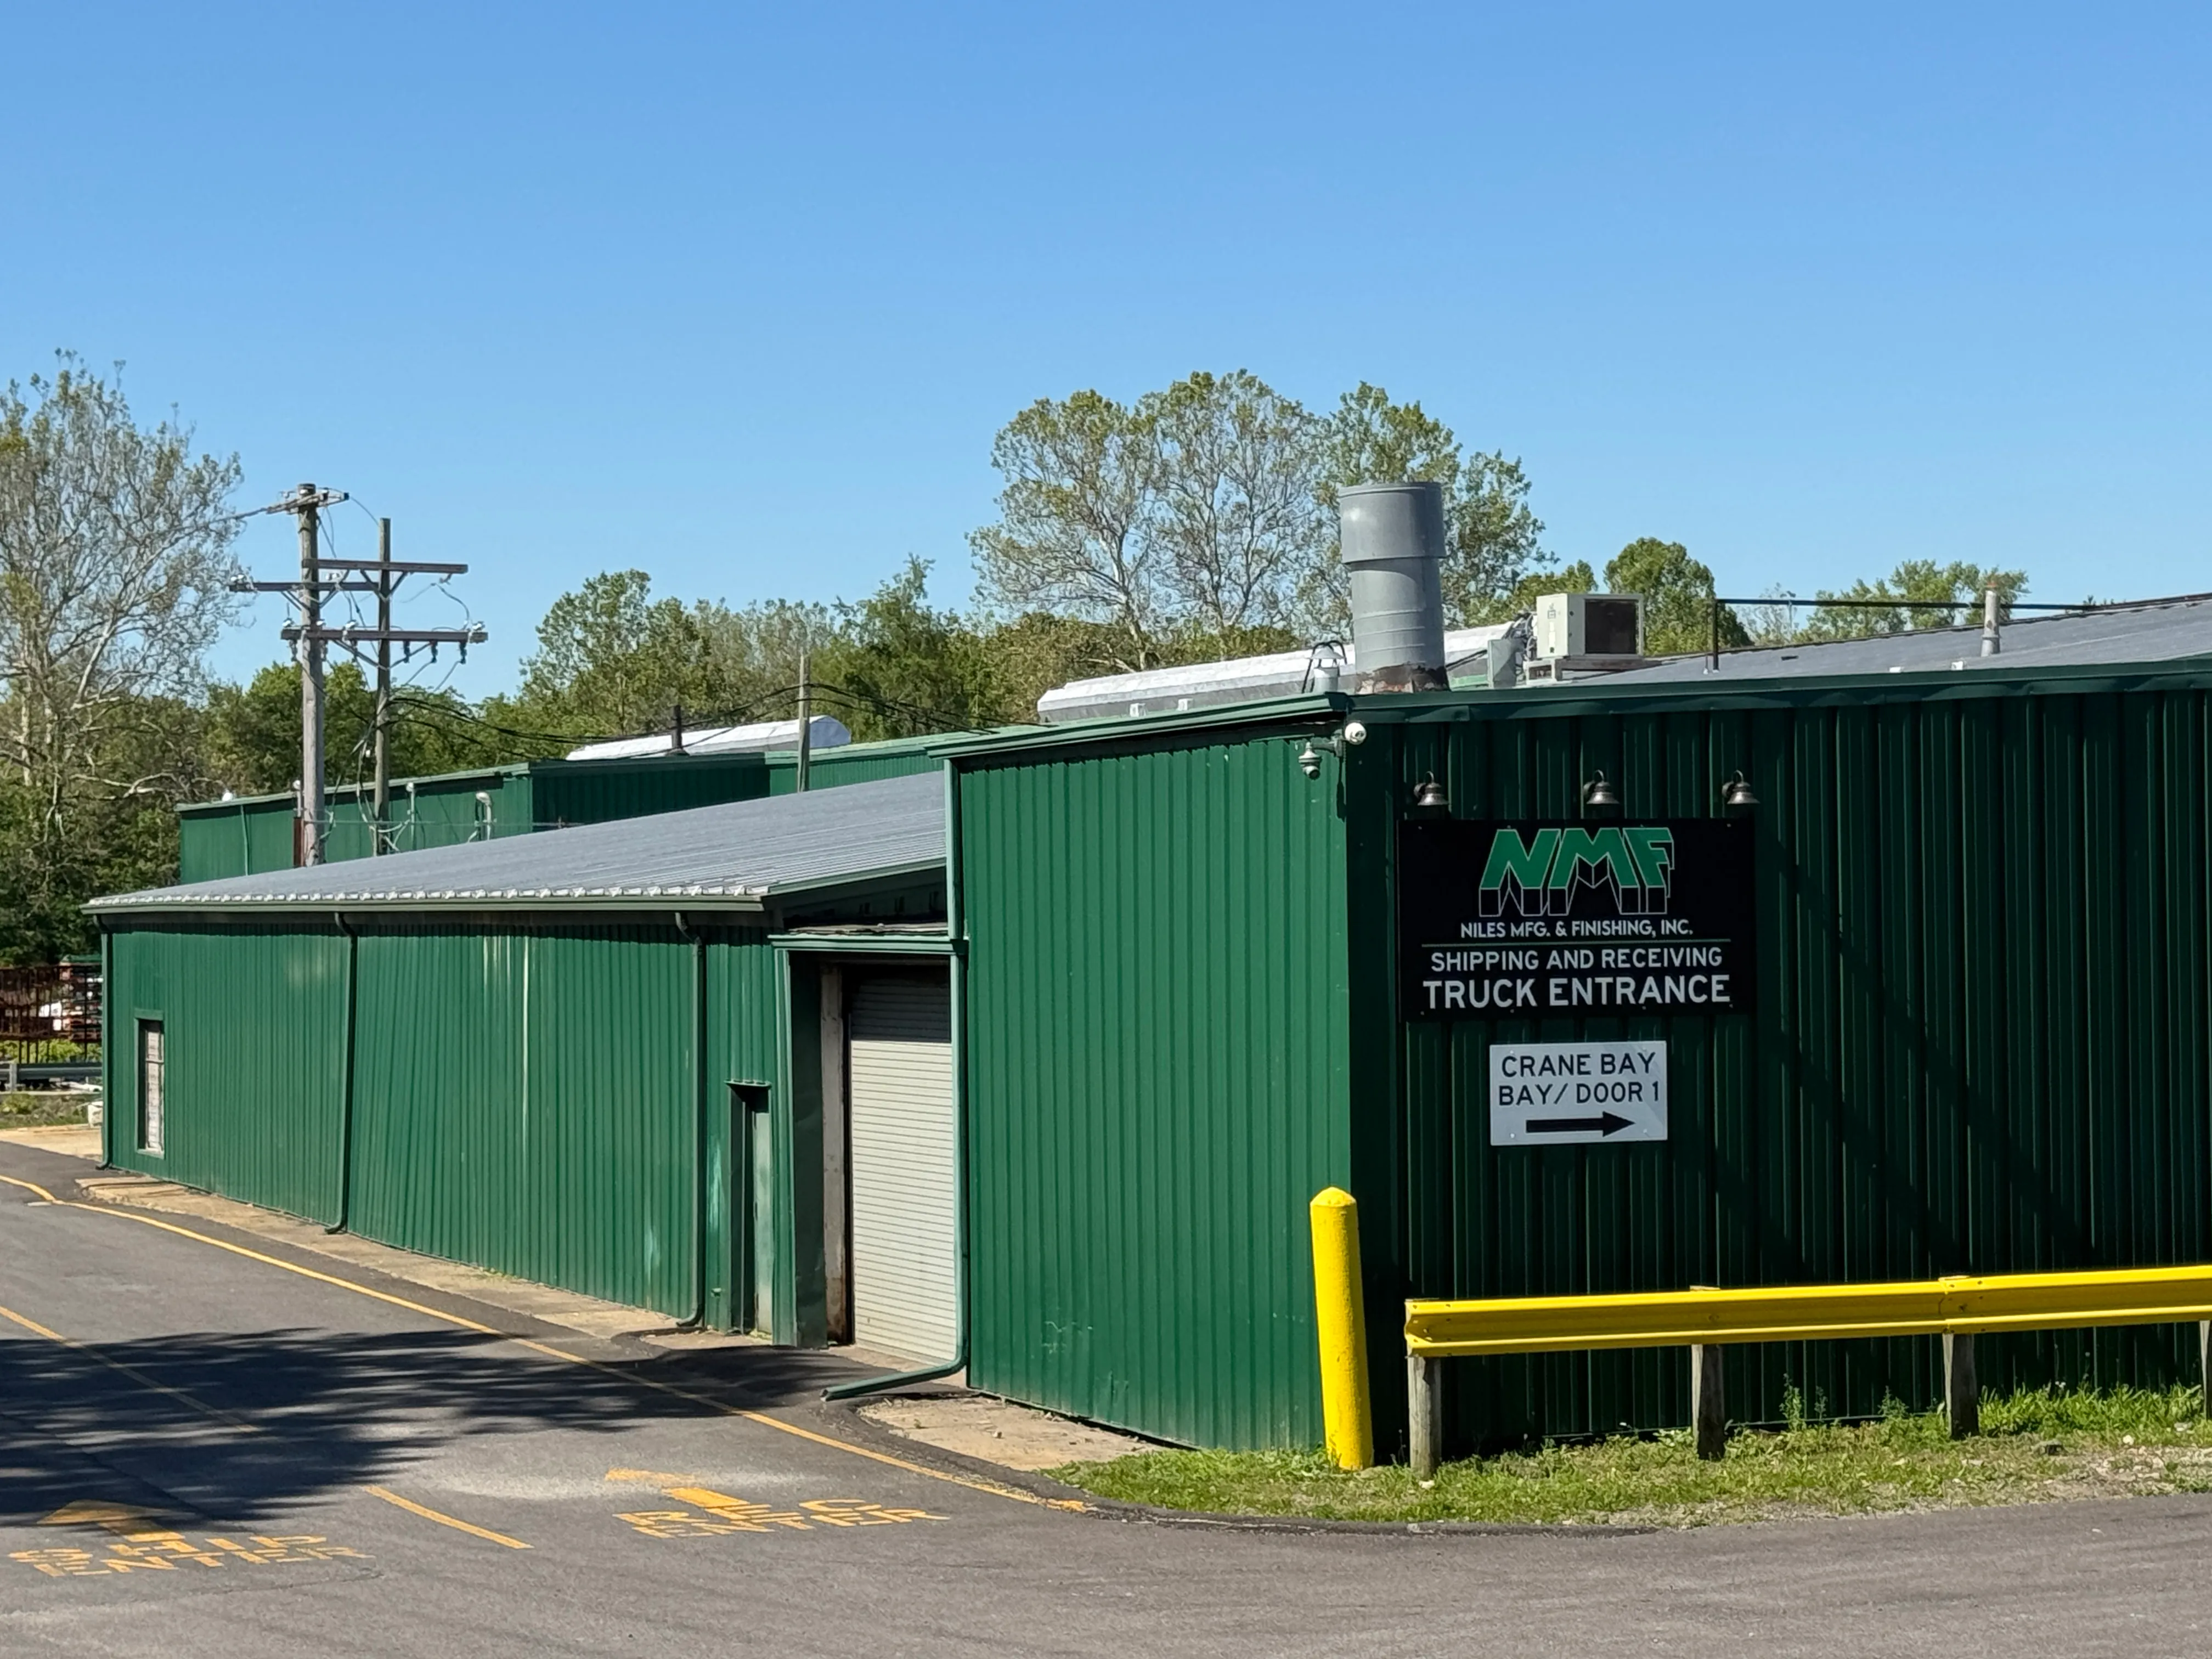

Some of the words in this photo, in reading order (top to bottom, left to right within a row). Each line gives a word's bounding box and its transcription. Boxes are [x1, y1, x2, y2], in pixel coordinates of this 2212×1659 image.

[1479, 827, 1674, 917] NMF
[1462, 922, 1505, 938] NILES
[1511, 922, 1550, 937] MFG.
[1556, 921, 1567, 936] &
[1572, 920, 1656, 937] FINISHING,
[1661, 919, 1692, 934] INC.
[1432, 951, 1538, 971] SHIPPING
[1547, 950, 1594, 969] AND
[1602, 947, 1722, 968] RECEIVING
[1423, 979, 1537, 1008] TRUCK
[1550, 975, 1730, 1006] ENTRANCE
[1502, 1054, 1591, 1077] CRANE
[1601, 1052, 1655, 1074] BAY
[1652, 1081, 1658, 1101] 1
[633, 1508, 950, 1538] ENTER
[8, 1536, 327, 1562] SHIP
[33, 1547, 376, 1577] ENTER
